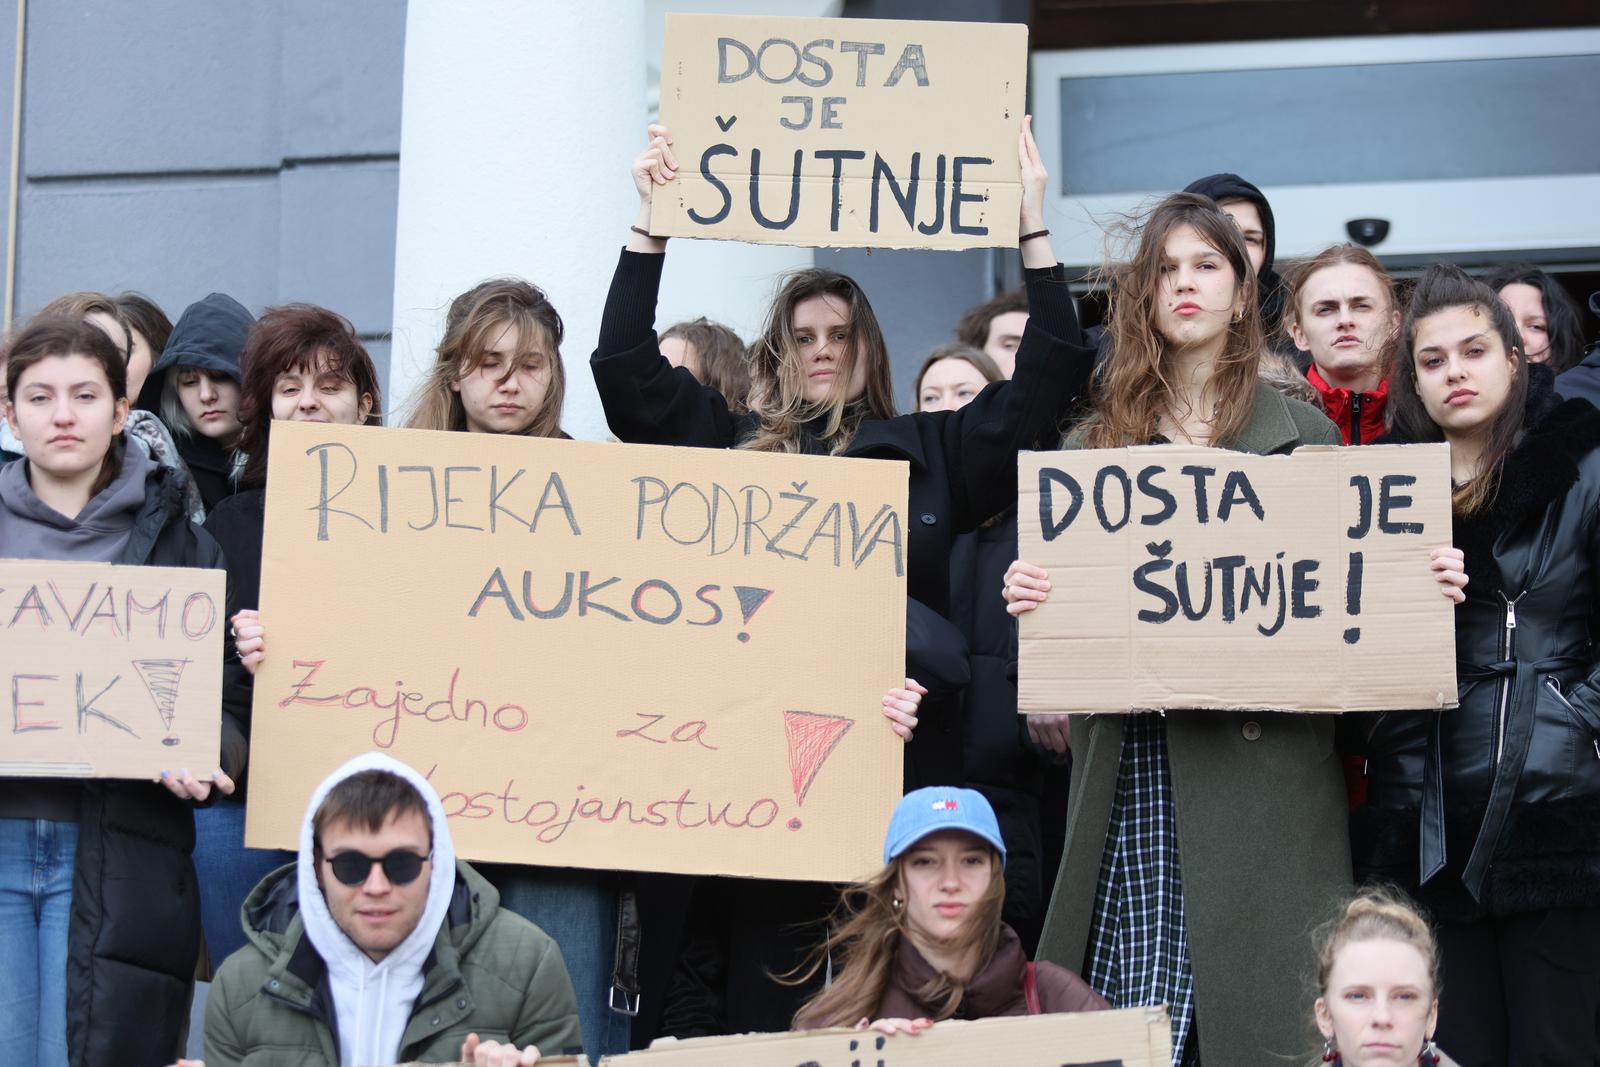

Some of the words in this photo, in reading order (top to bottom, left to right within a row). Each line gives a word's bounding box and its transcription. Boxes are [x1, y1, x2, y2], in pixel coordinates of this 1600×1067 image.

[718, 37, 929, 88] DOSTA
[780, 96, 847, 130] JE
[687, 115, 994, 236] ŠUTNJE
[306, 442, 581, 541] RIJEKA
[631, 476, 905, 577] PODRŽAVA
[1038, 465, 1265, 542] DOSTA
[1346, 474, 1424, 540] JE
[0, 579, 217, 641] AVAMO
[468, 566, 775, 643] AUKOS!
[279, 660, 529, 748] Zajedno
[616, 711, 719, 750] za
[425, 711, 855, 843] ostojanstvo!
